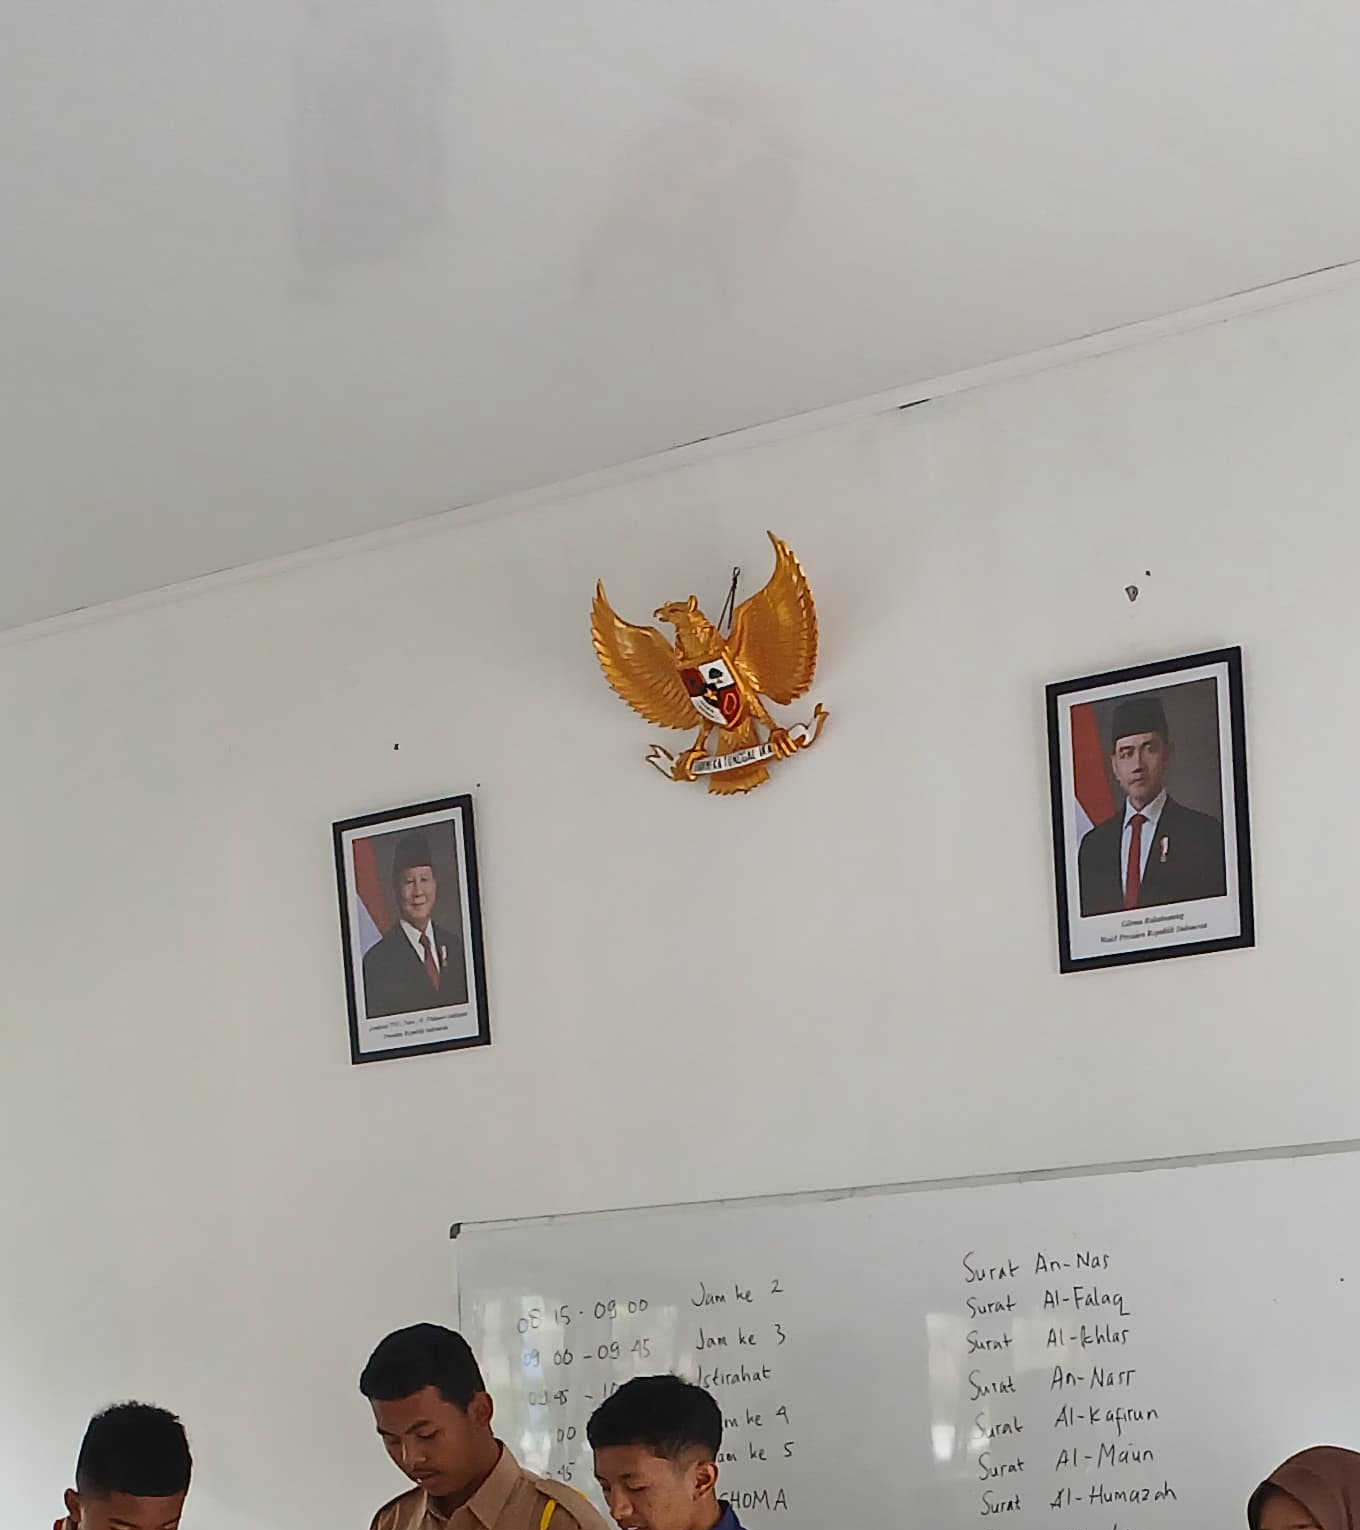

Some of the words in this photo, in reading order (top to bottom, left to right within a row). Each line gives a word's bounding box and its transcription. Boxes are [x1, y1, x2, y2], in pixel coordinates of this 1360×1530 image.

[962, 1251, 1020, 1283] Surat
[1034, 1251, 1110, 1275] An-Nas
[691, 1281, 727, 1307] Jam
[735, 1284, 754, 1303] ke
[770, 1280, 784, 1294] 2
[966, 1295, 1016, 1319] Surat
[696, 1327, 728, 1350] Jam
[738, 1327, 757, 1346] ke
[774, 1324, 786, 1346] 3
[966, 1330, 1014, 1354] Surat
[968, 1370, 1016, 1401] Surat
[746, 1408, 763, 1427] ke
[974, 1411, 1024, 1440] Surat
[749, 1442, 768, 1461] ke
[783, 1441, 795, 1458] 5
[978, 1451, 1025, 1481] Surat
[980, 1490, 1022, 1516] Surat
